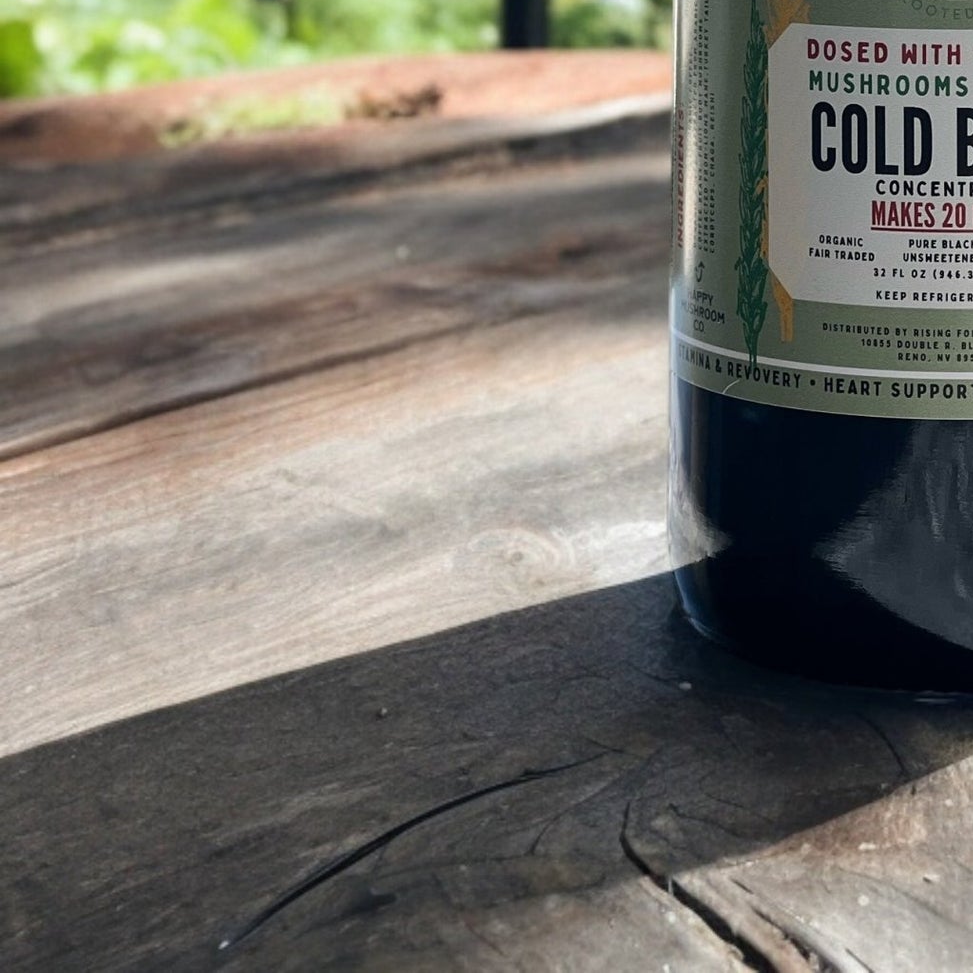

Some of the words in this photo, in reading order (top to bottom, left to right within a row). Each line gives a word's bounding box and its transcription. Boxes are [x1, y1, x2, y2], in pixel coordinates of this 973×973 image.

[807, 38, 889, 63] DOSED
[901, 42, 961, 65] WITH
[809, 70, 968, 97] MUSHROOMS
[811, 101, 933, 176] COLD
[871, 200, 936, 228] MAKES
[942, 202, 966, 228] 20
[819, 234, 864, 247] ORGANIC
[908, 239, 937, 249] PURE
[809, 248, 831, 259] FAIR
[835, 249, 875, 262] TRADED
[873, 267, 887, 277] 32
[892, 268, 905, 278] FL
[911, 268, 926, 279] OZ
[876, 290, 907, 301] KEEP
[822, 322, 890, 336] DISTRIBUTED
[895, 327, 908, 337] BY
[913, 327, 951, 338] RISING
[897, 340, 939, 350] DOUBLE
[944, 341, 956, 351] R.
[897, 352, 931, 363] RENO,
[937, 353, 951, 362] NV
[715, 360, 722, 374] &
[727, 361, 801, 389] REVOVERY
[824, 377, 882, 397] HEART
